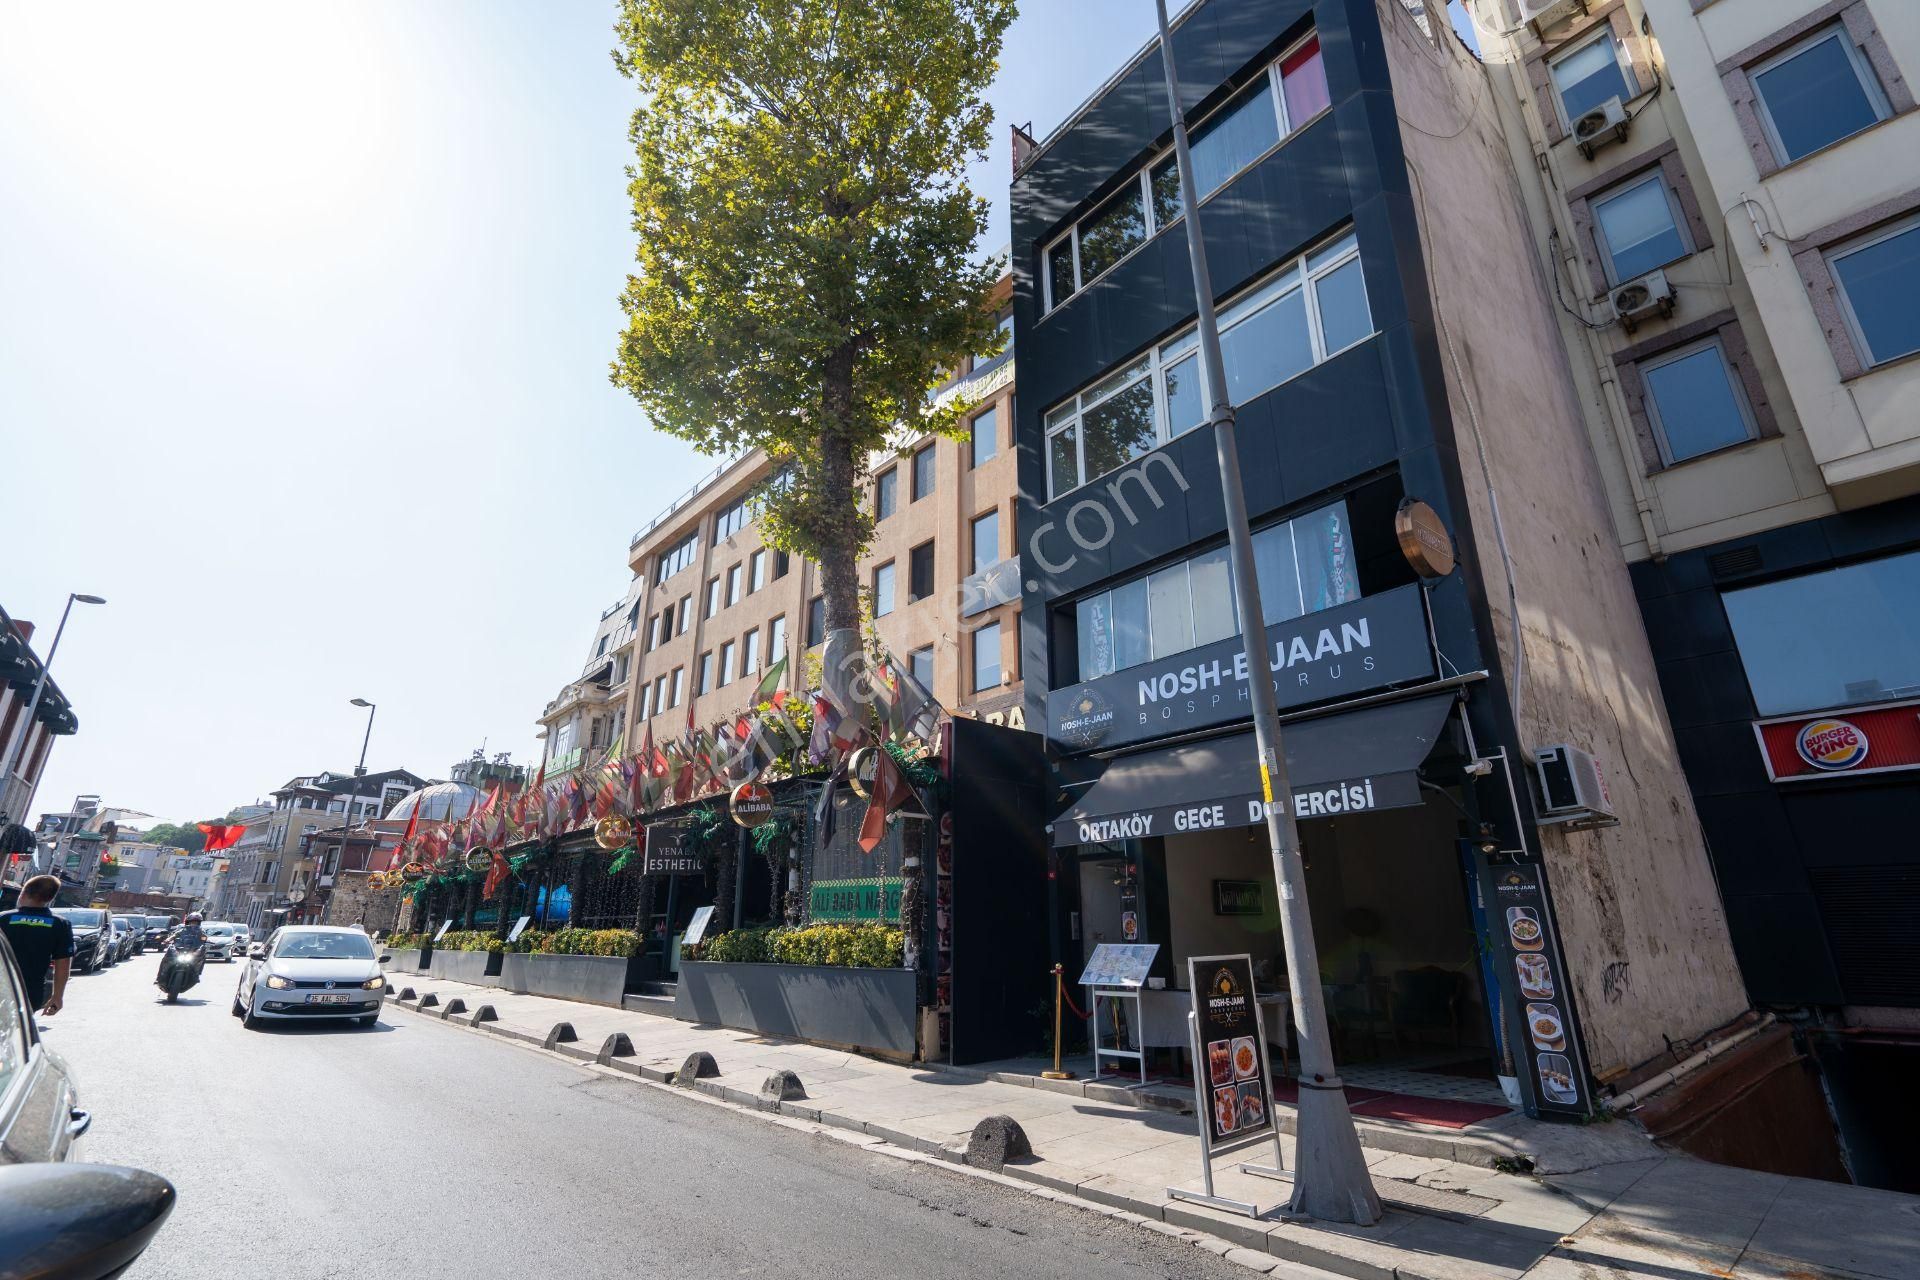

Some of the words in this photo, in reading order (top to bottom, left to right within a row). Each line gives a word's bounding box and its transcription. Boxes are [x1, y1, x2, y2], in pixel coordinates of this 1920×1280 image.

[1139, 618, 1371, 706] NOSH-EJAAN
[1061, 711, 1113, 731] NOSH-E-JAAN
[1805, 726, 1853, 749] BURGER
[1810, 734, 1858, 760] KING
[1079, 813, 1153, 842] ORTAKÖY
[1174, 805, 1225, 831] GECE
[1248, 778, 1375, 822] DERCİSİ
[649, 859, 704, 870] ESTHETIC
